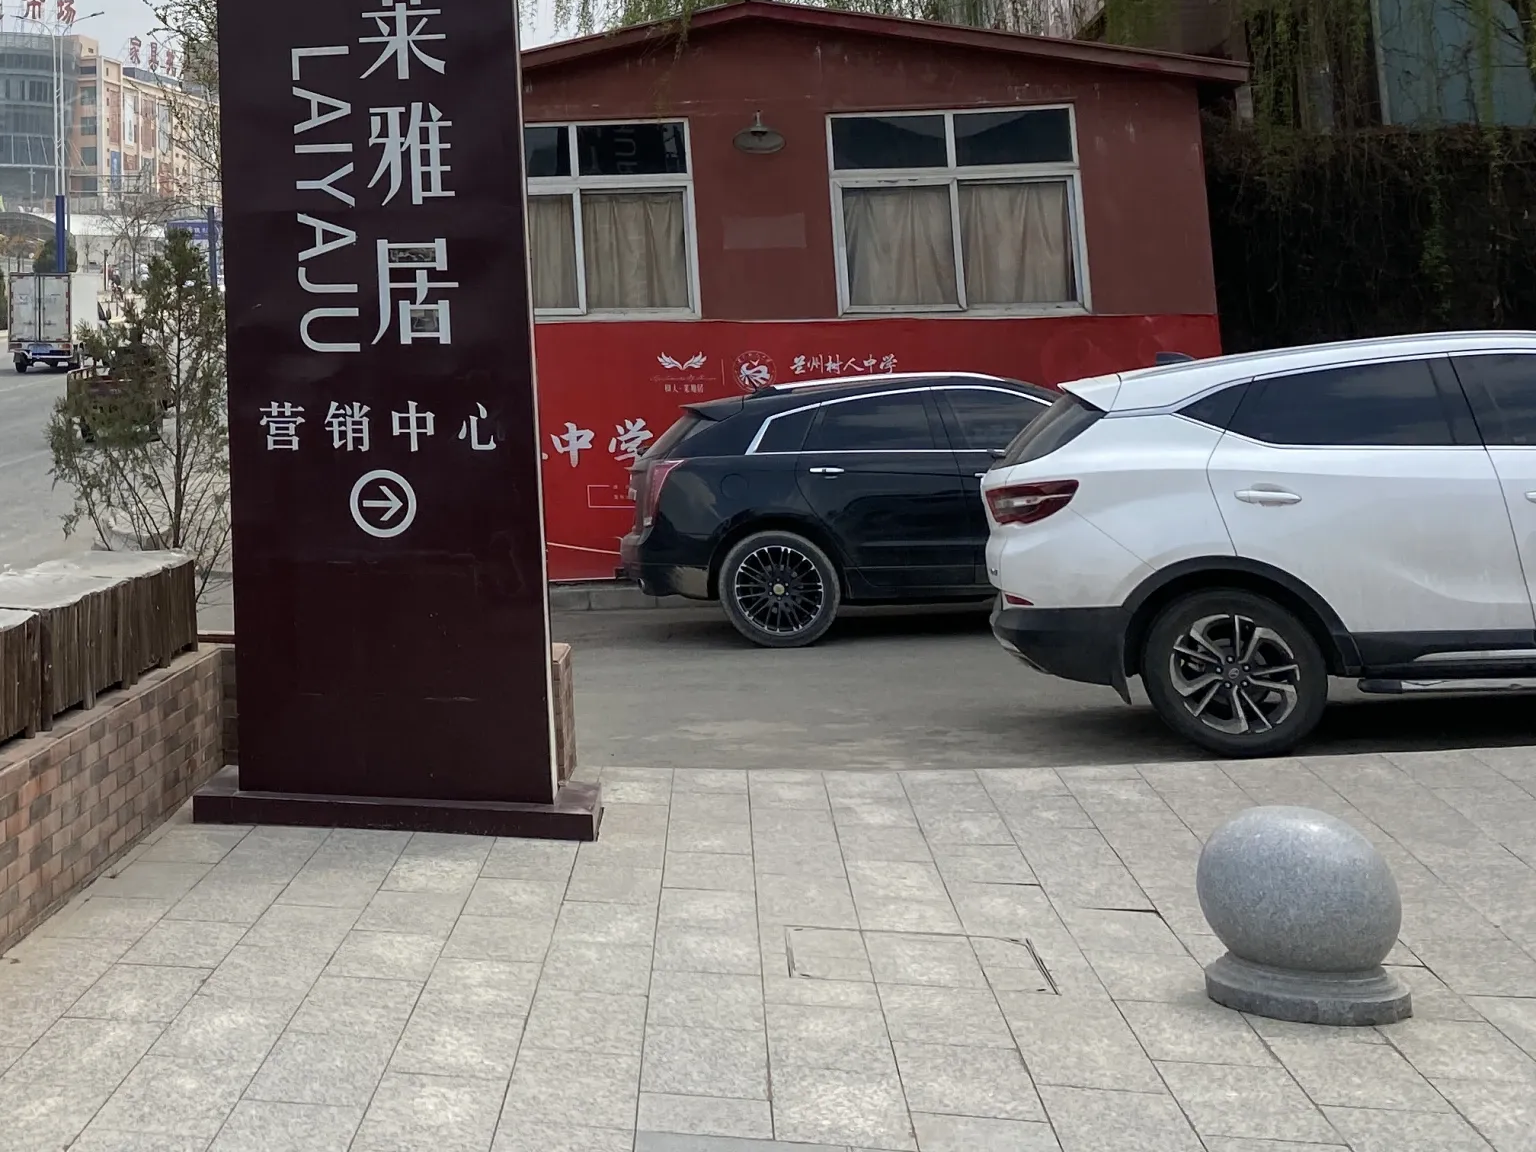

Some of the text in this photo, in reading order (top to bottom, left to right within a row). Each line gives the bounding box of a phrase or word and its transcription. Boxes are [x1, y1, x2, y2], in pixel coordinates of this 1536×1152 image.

[290, 45, 361, 352] LAIYAJU
[259, 400, 496, 452] 营销中心
